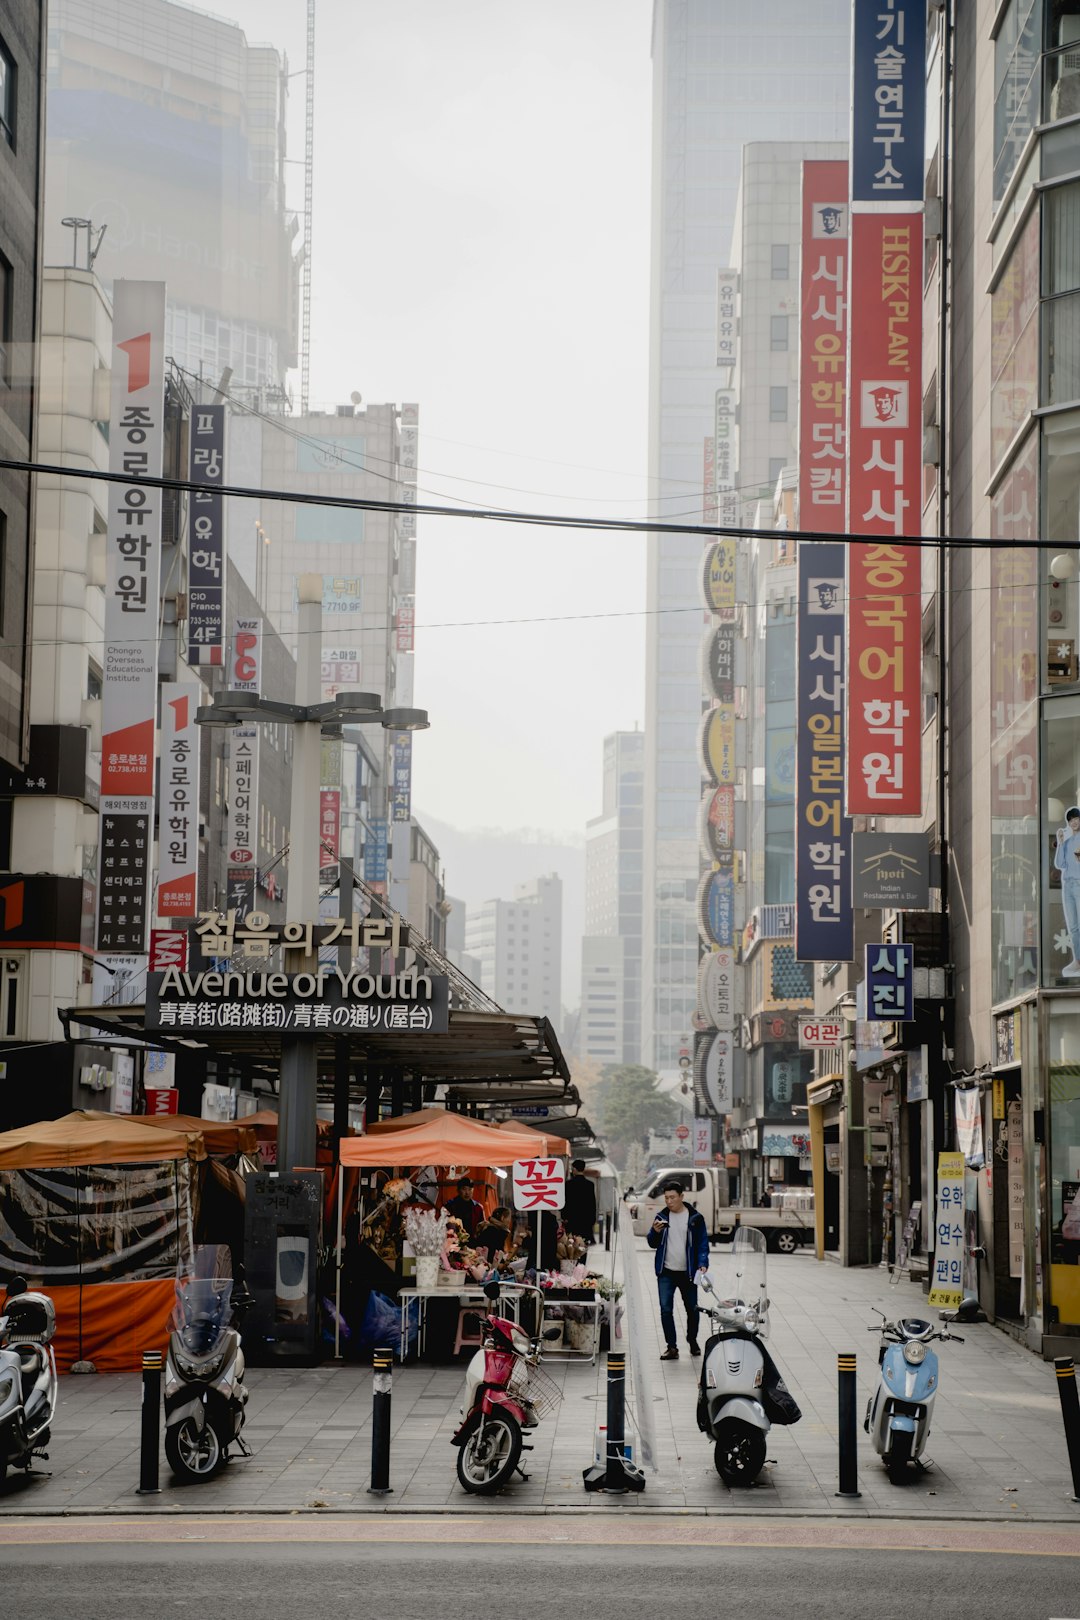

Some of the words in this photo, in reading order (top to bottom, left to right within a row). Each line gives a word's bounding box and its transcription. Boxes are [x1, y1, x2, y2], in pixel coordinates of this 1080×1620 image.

[872, 0, 906, 190] 기술연구소
[882, 226, 910, 301] HSK
[888, 302, 909, 366] PLAN
[810, 256, 846, 504] 시사유학닷컴
[192, 414, 222, 578] 프랑스유학
[116, 406, 154, 612] 종로유학원
[350, 602, 360, 610] 9F
[190, 617, 220, 625] 733-3366
[858, 440, 910, 800] 시사중국어학원
[194, 628, 216, 642] 4F
[107, 656, 144, 664] Overseas
[108, 646, 142, 656] Chongro
[235, 632, 258, 681] PC
[717, 640, 732, 680] 하바나
[106, 666, 153, 674] Educational
[108, 754, 147, 765] 종로본점
[26, 778, 46, 788] 뉴욕
[806, 635, 846, 922] 시사일본어학원
[104, 800, 148, 810] 해외직영점
[168, 740, 190, 864] 종로유학원
[234, 742, 252, 847] 스페인어학원
[395, 794, 409, 821] 치과
[105, 839, 144, 849] 보스턴
[104, 858, 144, 868] 샌프란
[234, 852, 248, 862] 9F
[104, 876, 144, 886] 샌디에고
[876, 868, 905, 881] jyoti
[104, 896, 142, 906] 밴쿠버
[162, 892, 192, 900] 종로본점
[102, 915, 142, 925] 토론토
[102, 934, 140, 944] 시드니
[196, 909, 313, 958] 젊음의
[321, 912, 401, 958] 거리
[155, 930, 184, 971] NA
[158, 964, 288, 998] Avenue
[292, 963, 328, 998] of
[332, 964, 432, 1000] Youth
[872, 948, 908, 1016] 사진
[804, 1024, 841, 1041] 여관
[514, 1160, 564, 1209] 꽃
[940, 1186, 963, 1210] 유학
[938, 1222, 963, 1247] 연수
[936, 1260, 961, 1284] 편입
